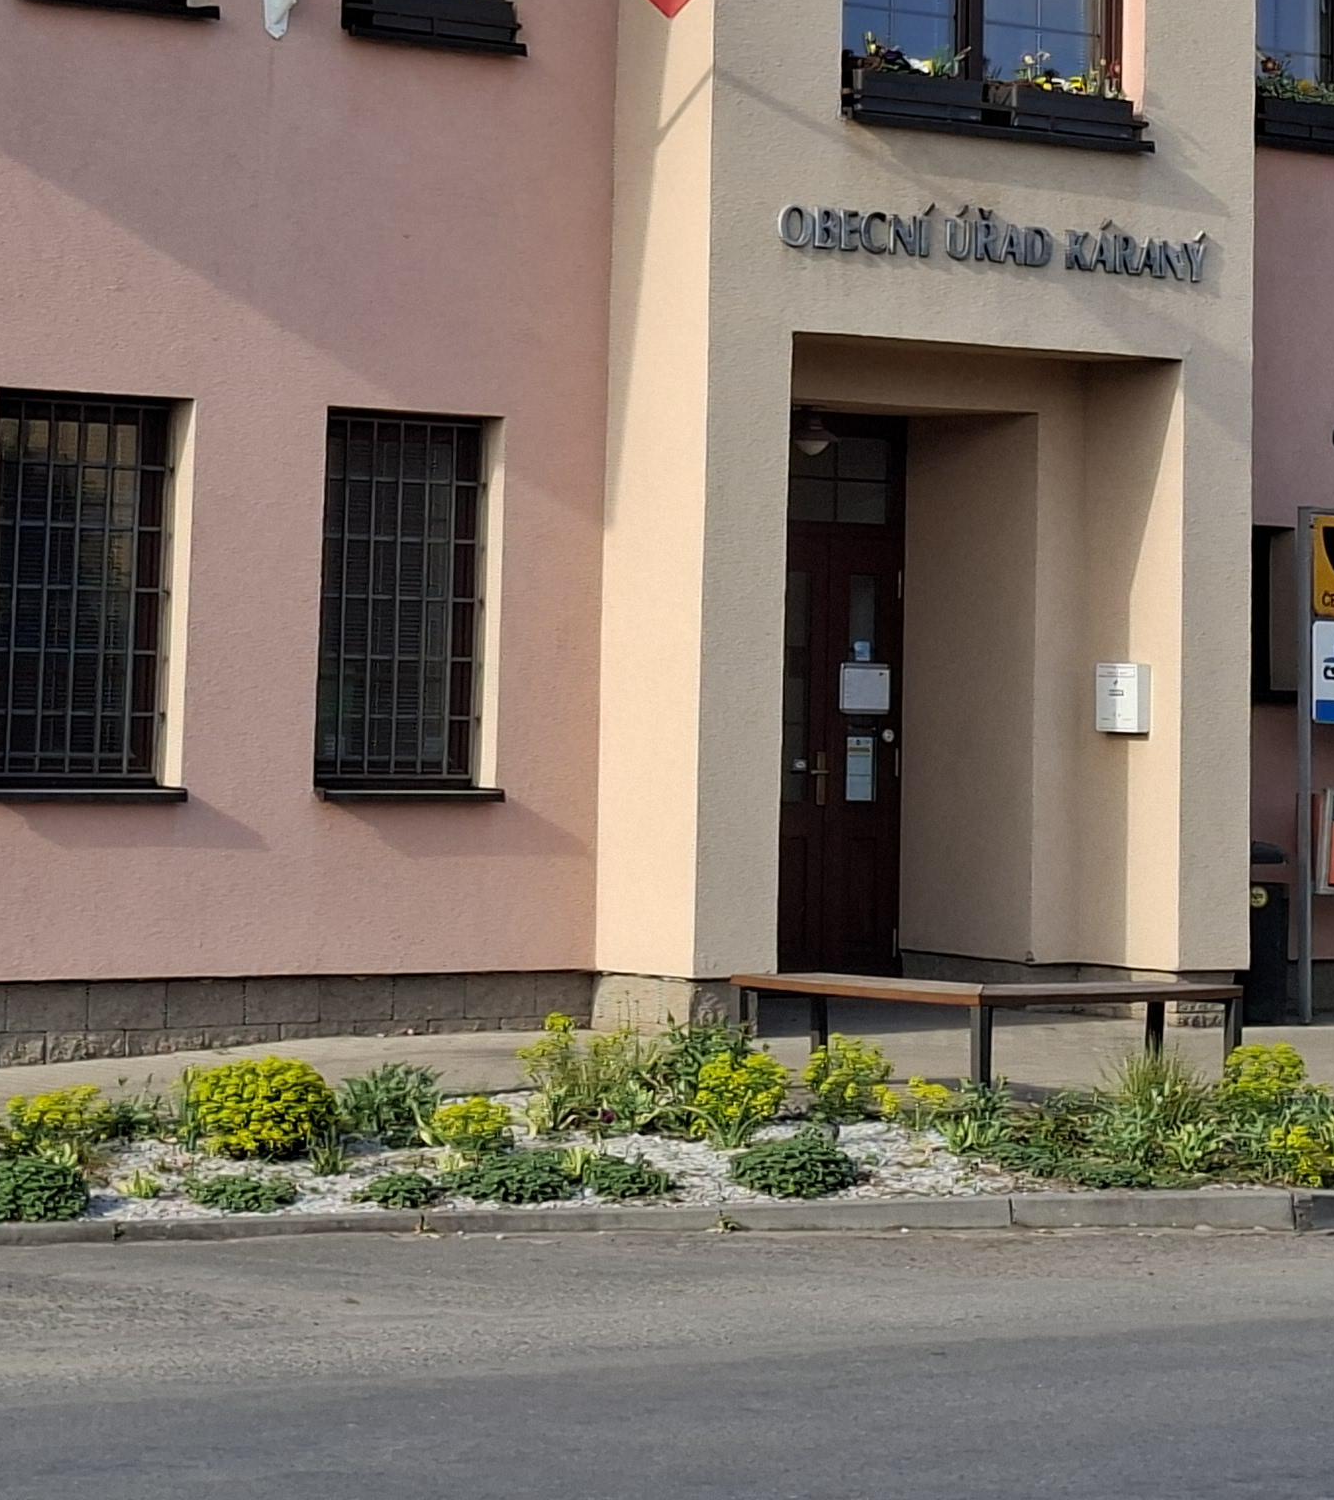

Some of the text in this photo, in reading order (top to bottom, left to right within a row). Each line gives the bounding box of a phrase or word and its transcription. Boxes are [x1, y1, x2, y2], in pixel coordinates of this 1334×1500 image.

[777, 202, 1208, 283] OBECNÍ ÚŘAD KÁRANÝ
